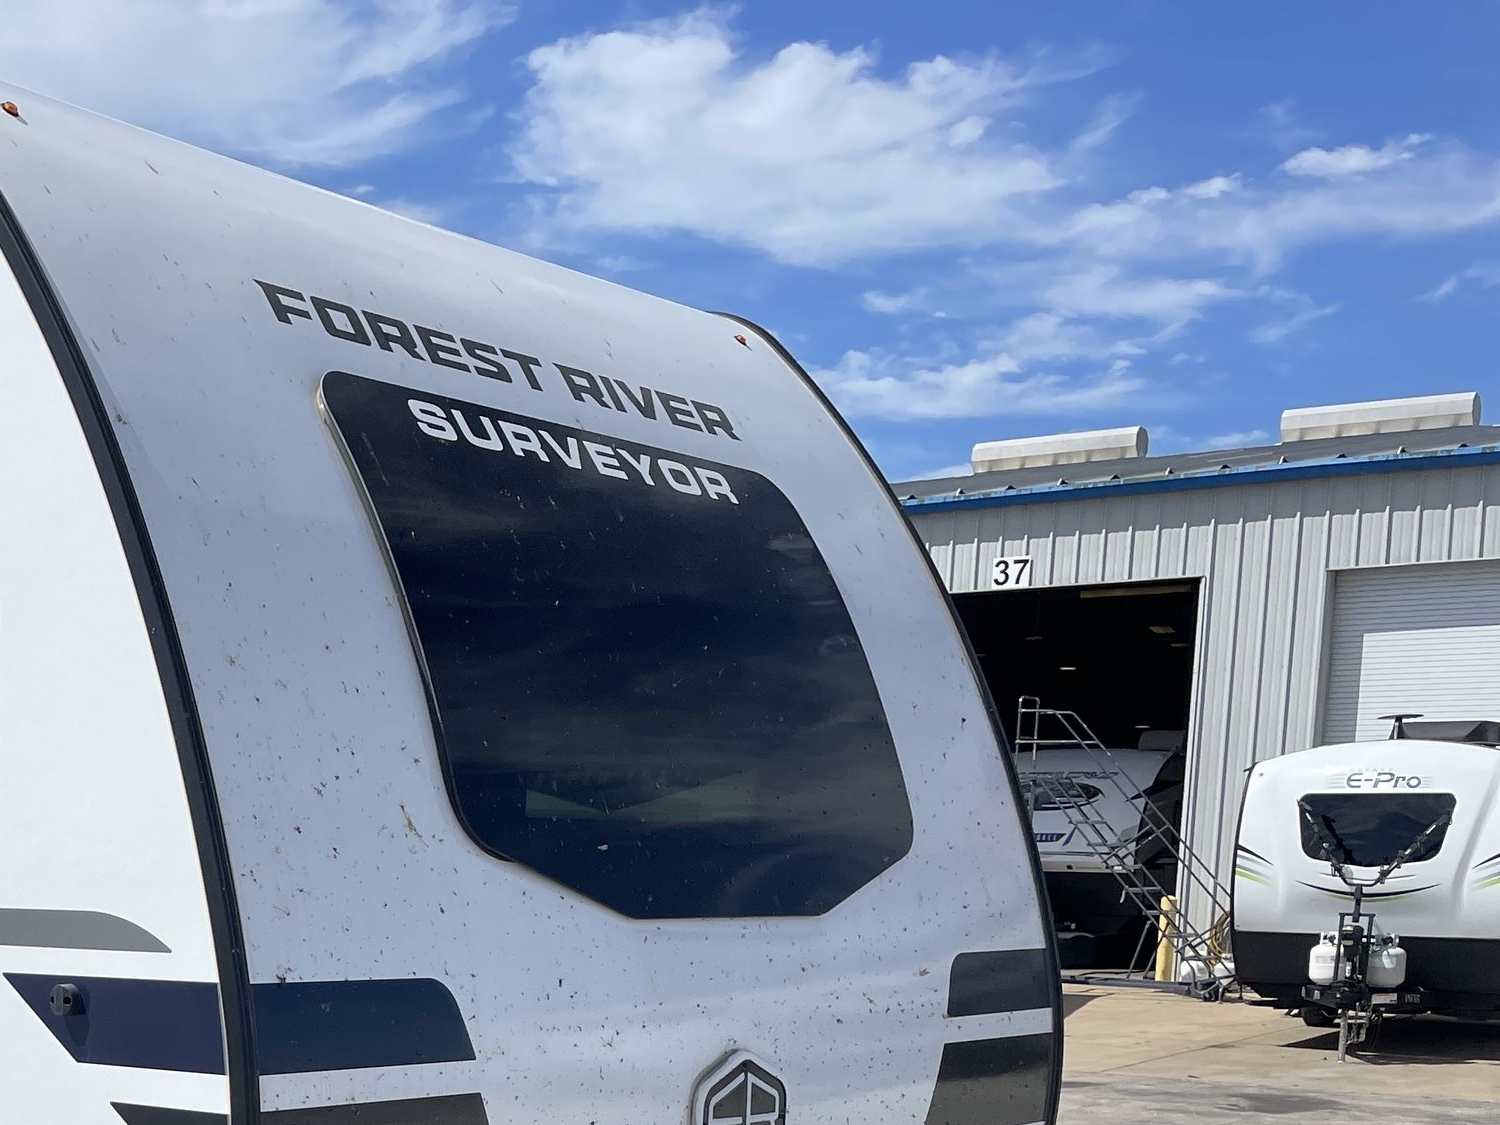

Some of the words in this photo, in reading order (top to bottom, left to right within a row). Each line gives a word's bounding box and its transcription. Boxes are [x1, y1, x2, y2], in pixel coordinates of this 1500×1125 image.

[252, 278, 544, 392] FOREST
[552, 361, 742, 442] RIVER
[407, 398, 740, 505] SURVEYOR
[993, 558, 1030, 586] 37
[1346, 772, 1422, 789] E-Pro
